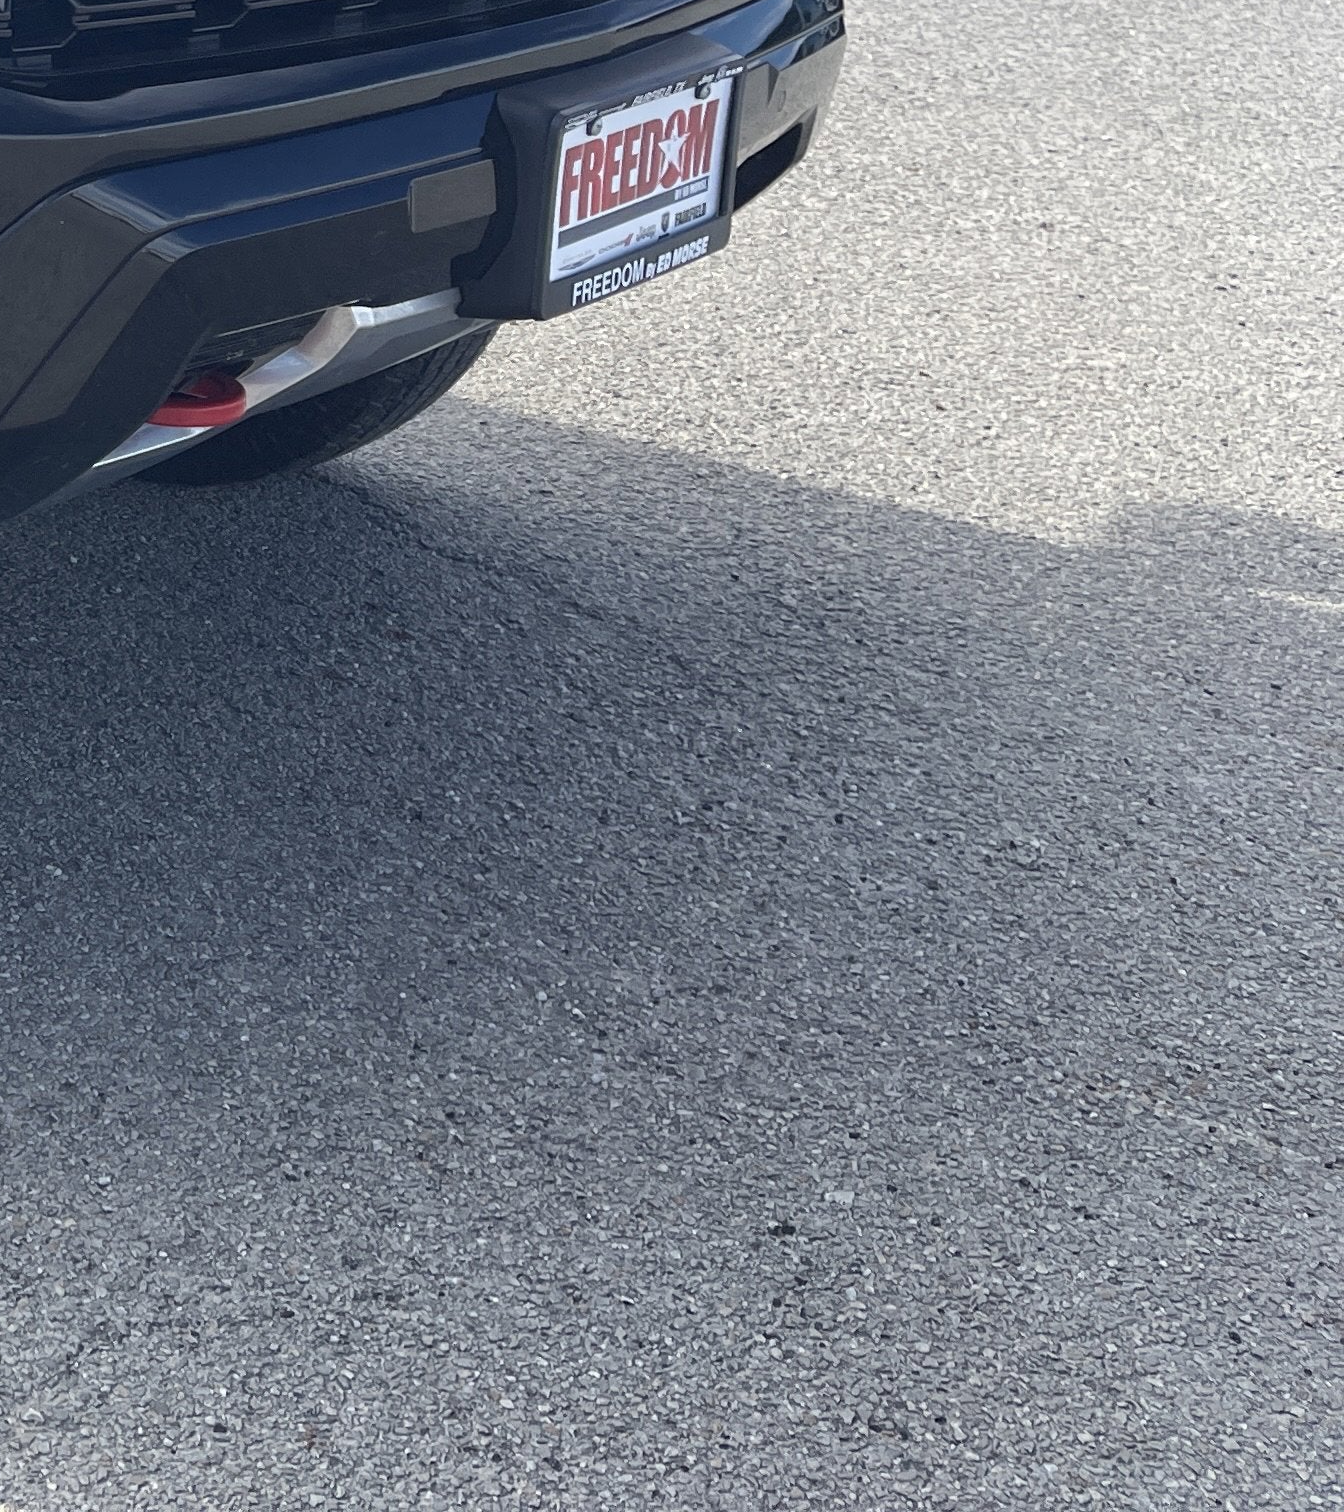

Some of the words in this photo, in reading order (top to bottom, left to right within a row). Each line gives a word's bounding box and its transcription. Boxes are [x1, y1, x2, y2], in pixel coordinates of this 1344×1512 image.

[559, 98, 720, 229] FREEDOM
[572, 257, 645, 307] FREEDOM
[656, 251, 672, 274] ED
[672, 235, 710, 268] MORSE
